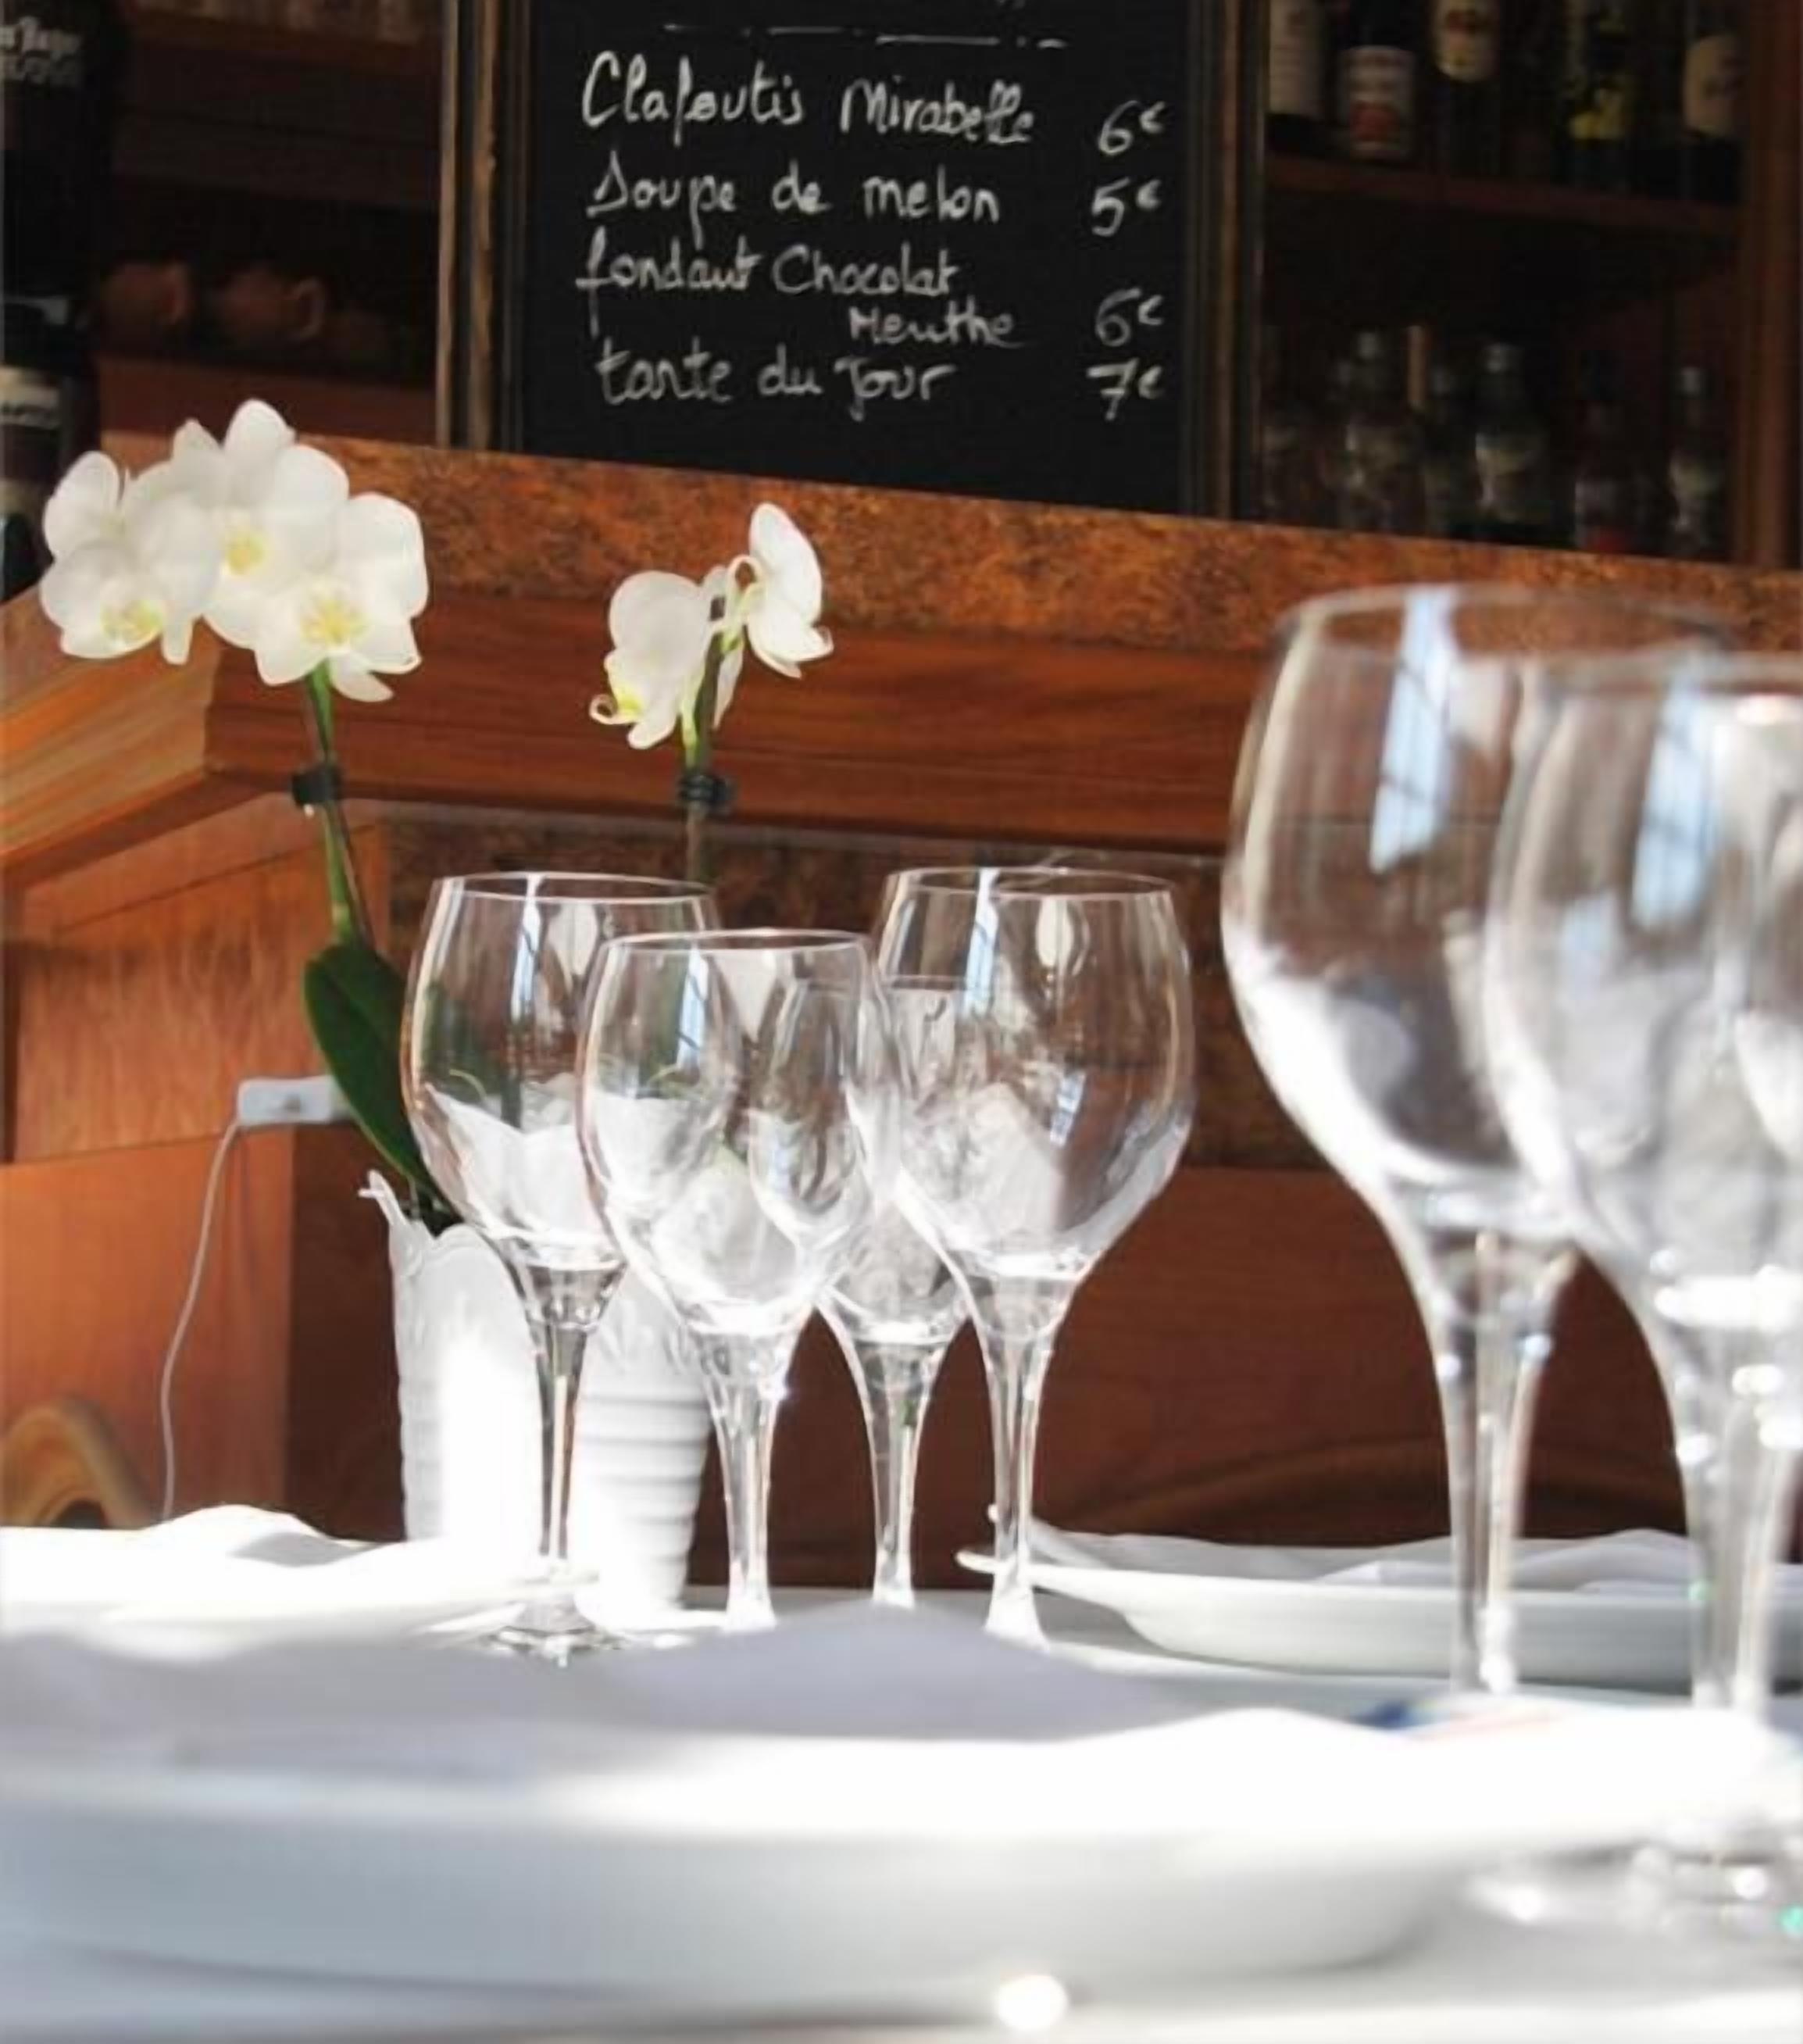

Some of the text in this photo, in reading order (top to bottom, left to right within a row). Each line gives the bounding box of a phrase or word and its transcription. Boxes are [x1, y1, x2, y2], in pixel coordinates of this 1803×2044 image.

[581, 49, 805, 147] Clafoutis
[839, 77, 1035, 146] Mirabelle
[586, 149, 738, 251] Soupe
[770, 159, 831, 216] de
[574, 224, 961, 338] fondant Chocolat
[757, 344, 824, 398] du
